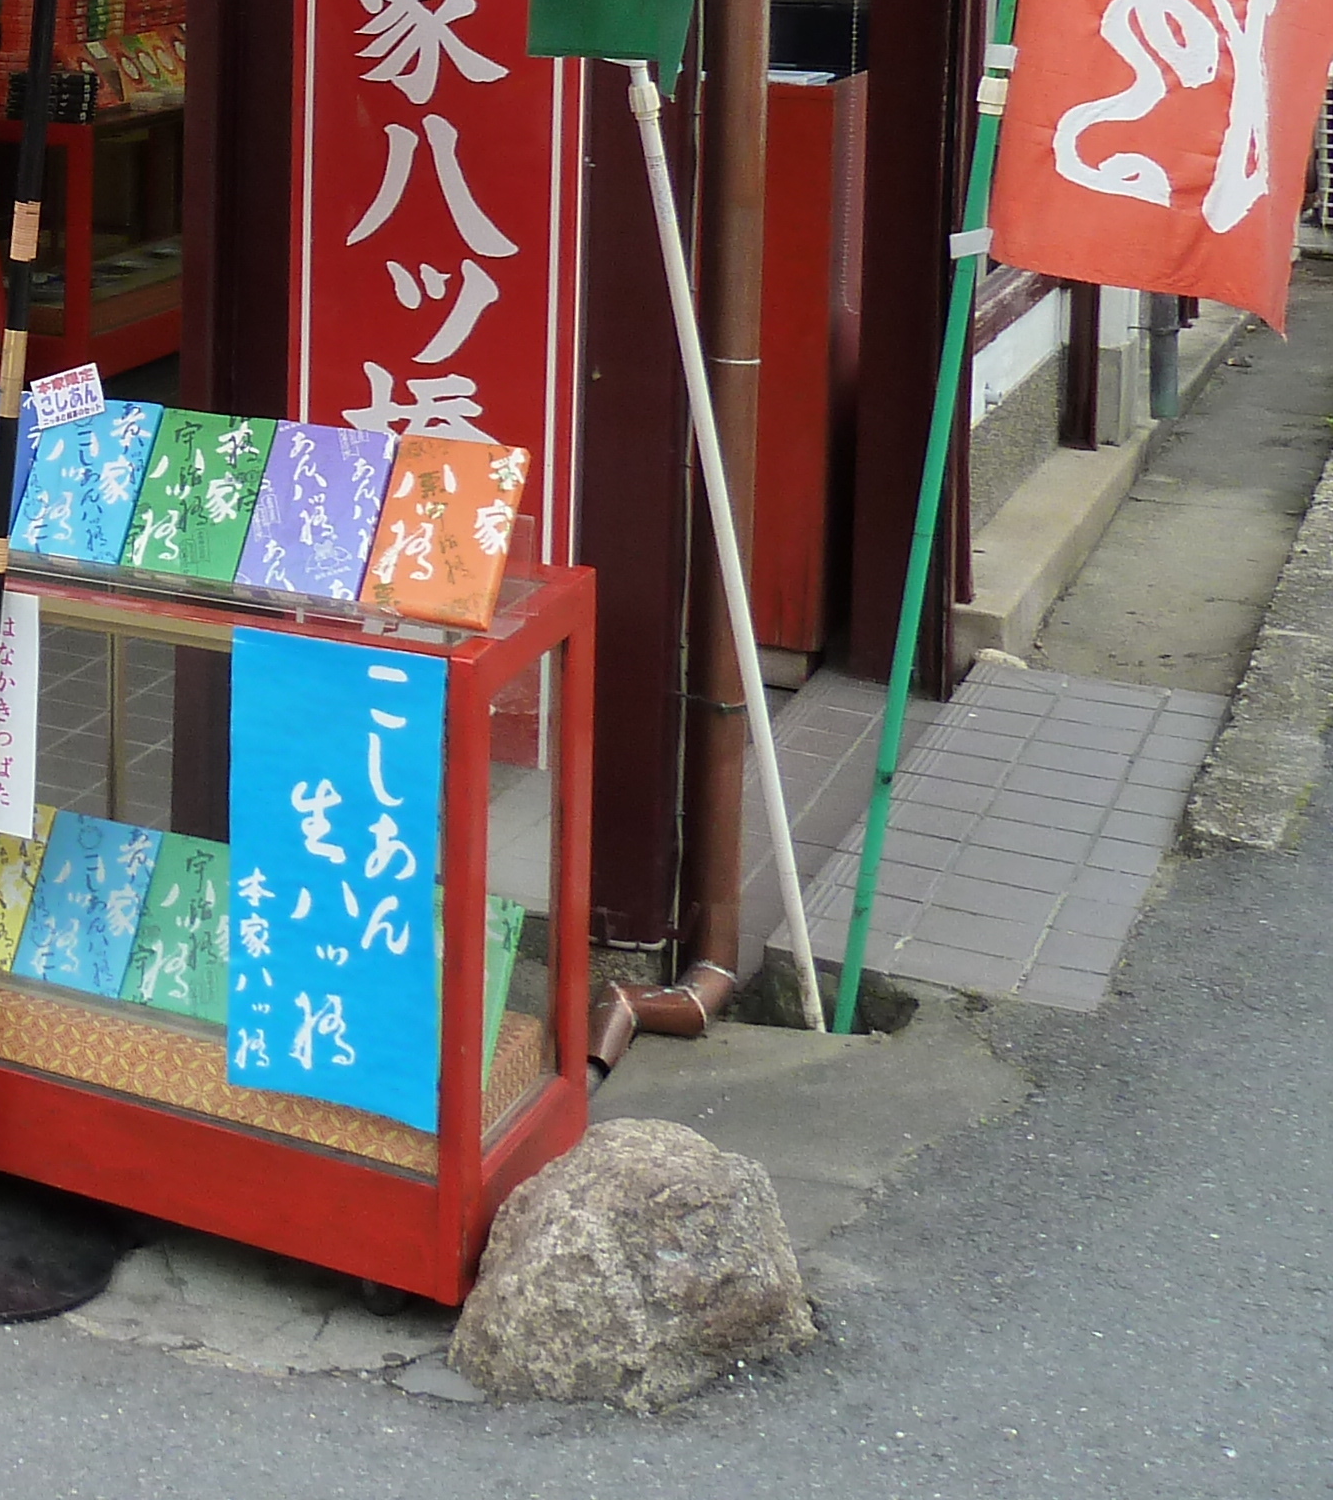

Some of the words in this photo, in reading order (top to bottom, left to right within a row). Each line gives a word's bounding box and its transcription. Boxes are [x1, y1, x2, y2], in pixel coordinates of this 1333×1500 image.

[36, 367, 96, 395] 本家限定
[40, 382, 99, 417] こしあん
[360, 664, 417, 956] こしあん
[288, 777, 360, 1071] 生八ツ橋
